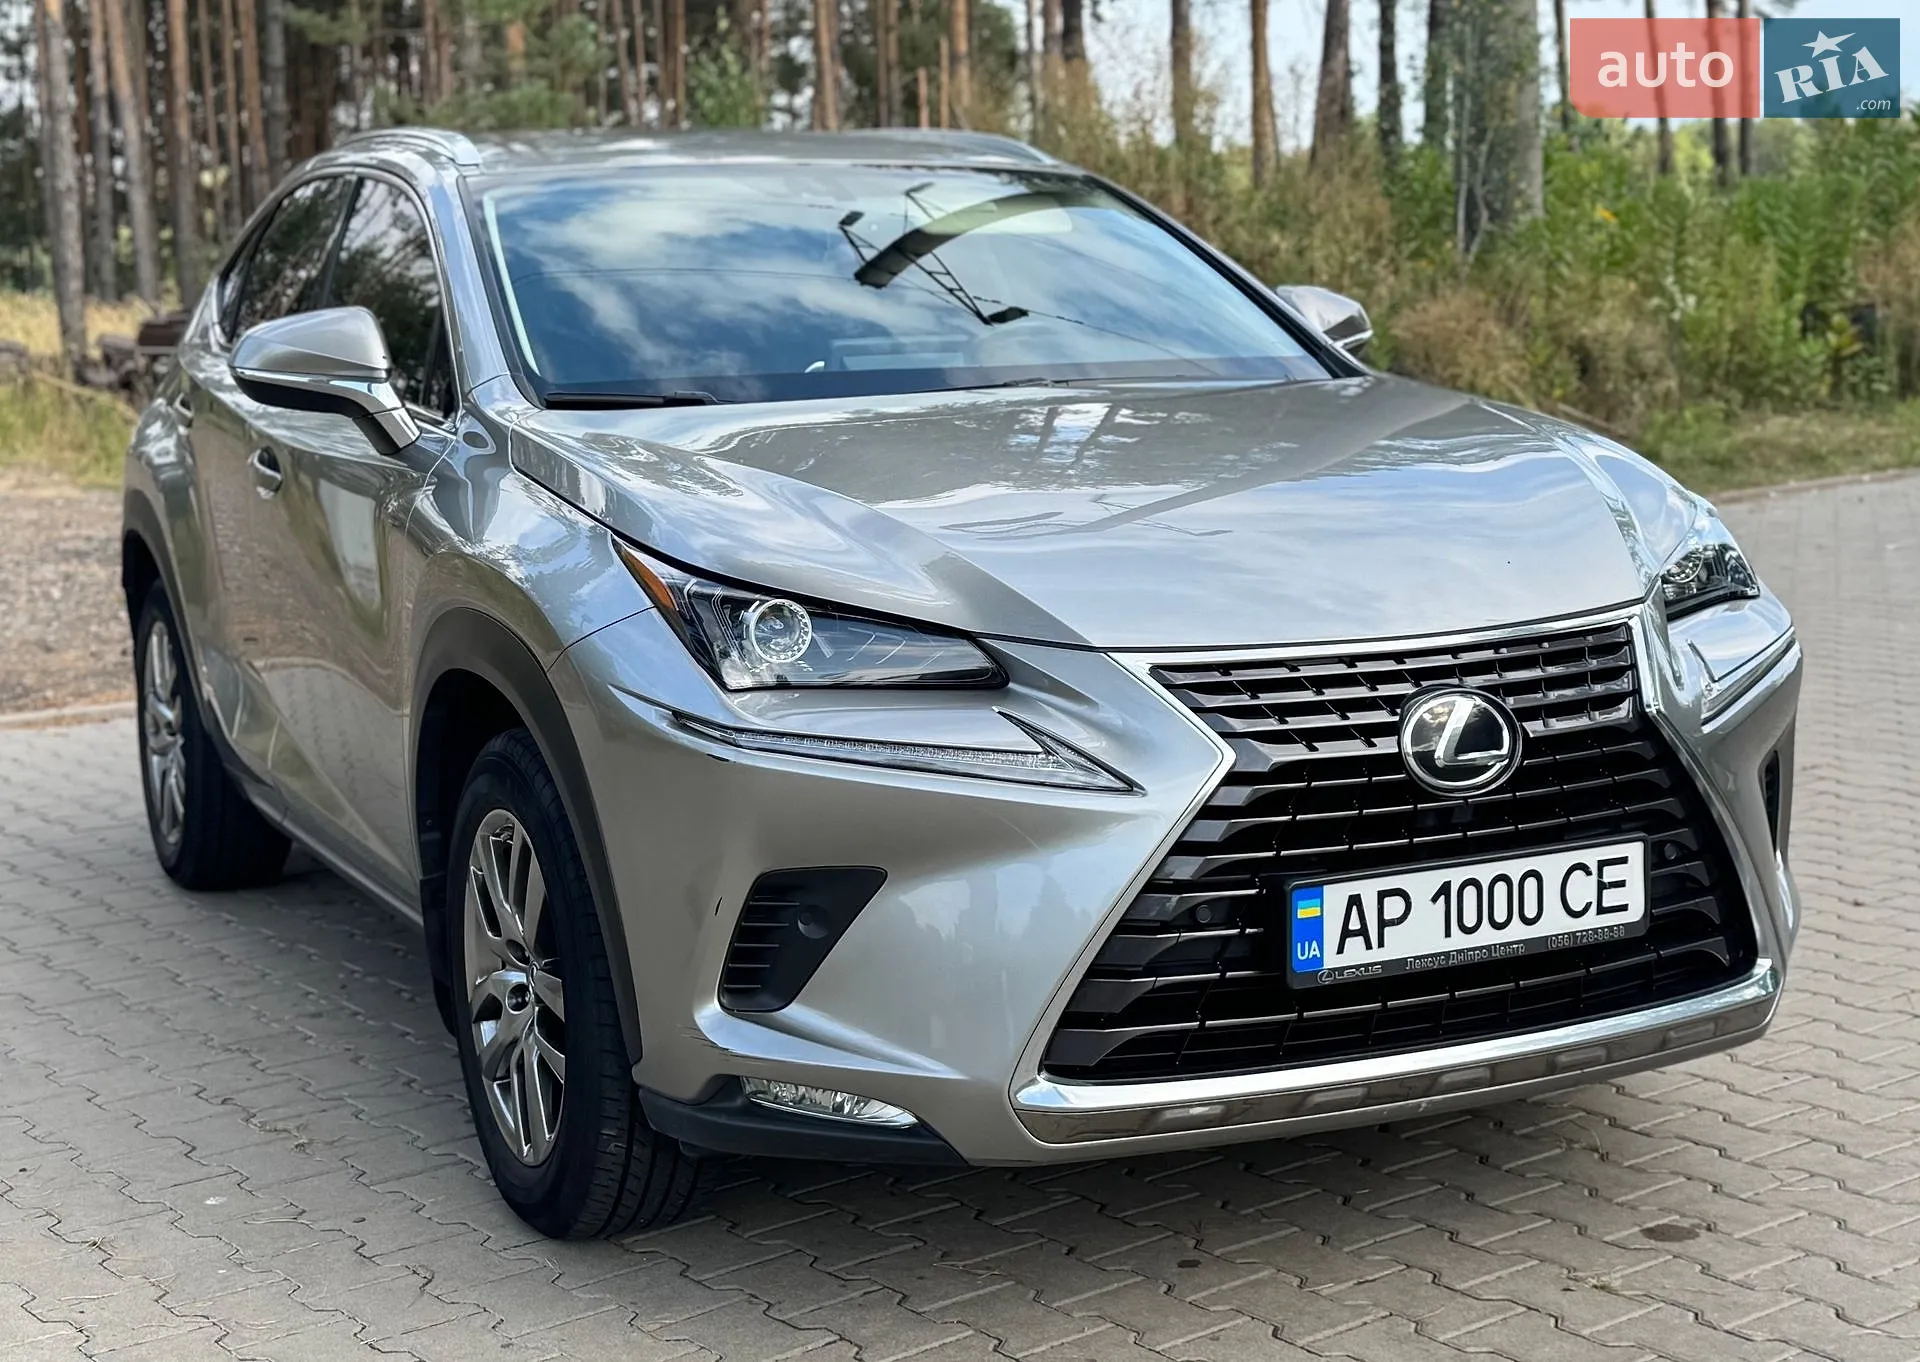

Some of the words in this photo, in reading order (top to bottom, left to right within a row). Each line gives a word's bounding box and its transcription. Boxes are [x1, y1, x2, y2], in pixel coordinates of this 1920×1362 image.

[1336, 887, 1413, 956] AP
[1430, 868, 1545, 939] 1000
[1559, 855, 1629, 919] CE
[1297, 941, 1321, 960] UA
[1406, 955, 1446, 970] Лексус
[1448, 949, 1489, 967] Дніпро
[1491, 942, 1526, 959] Центр
[1334, 964, 1383, 980] LEXUS
